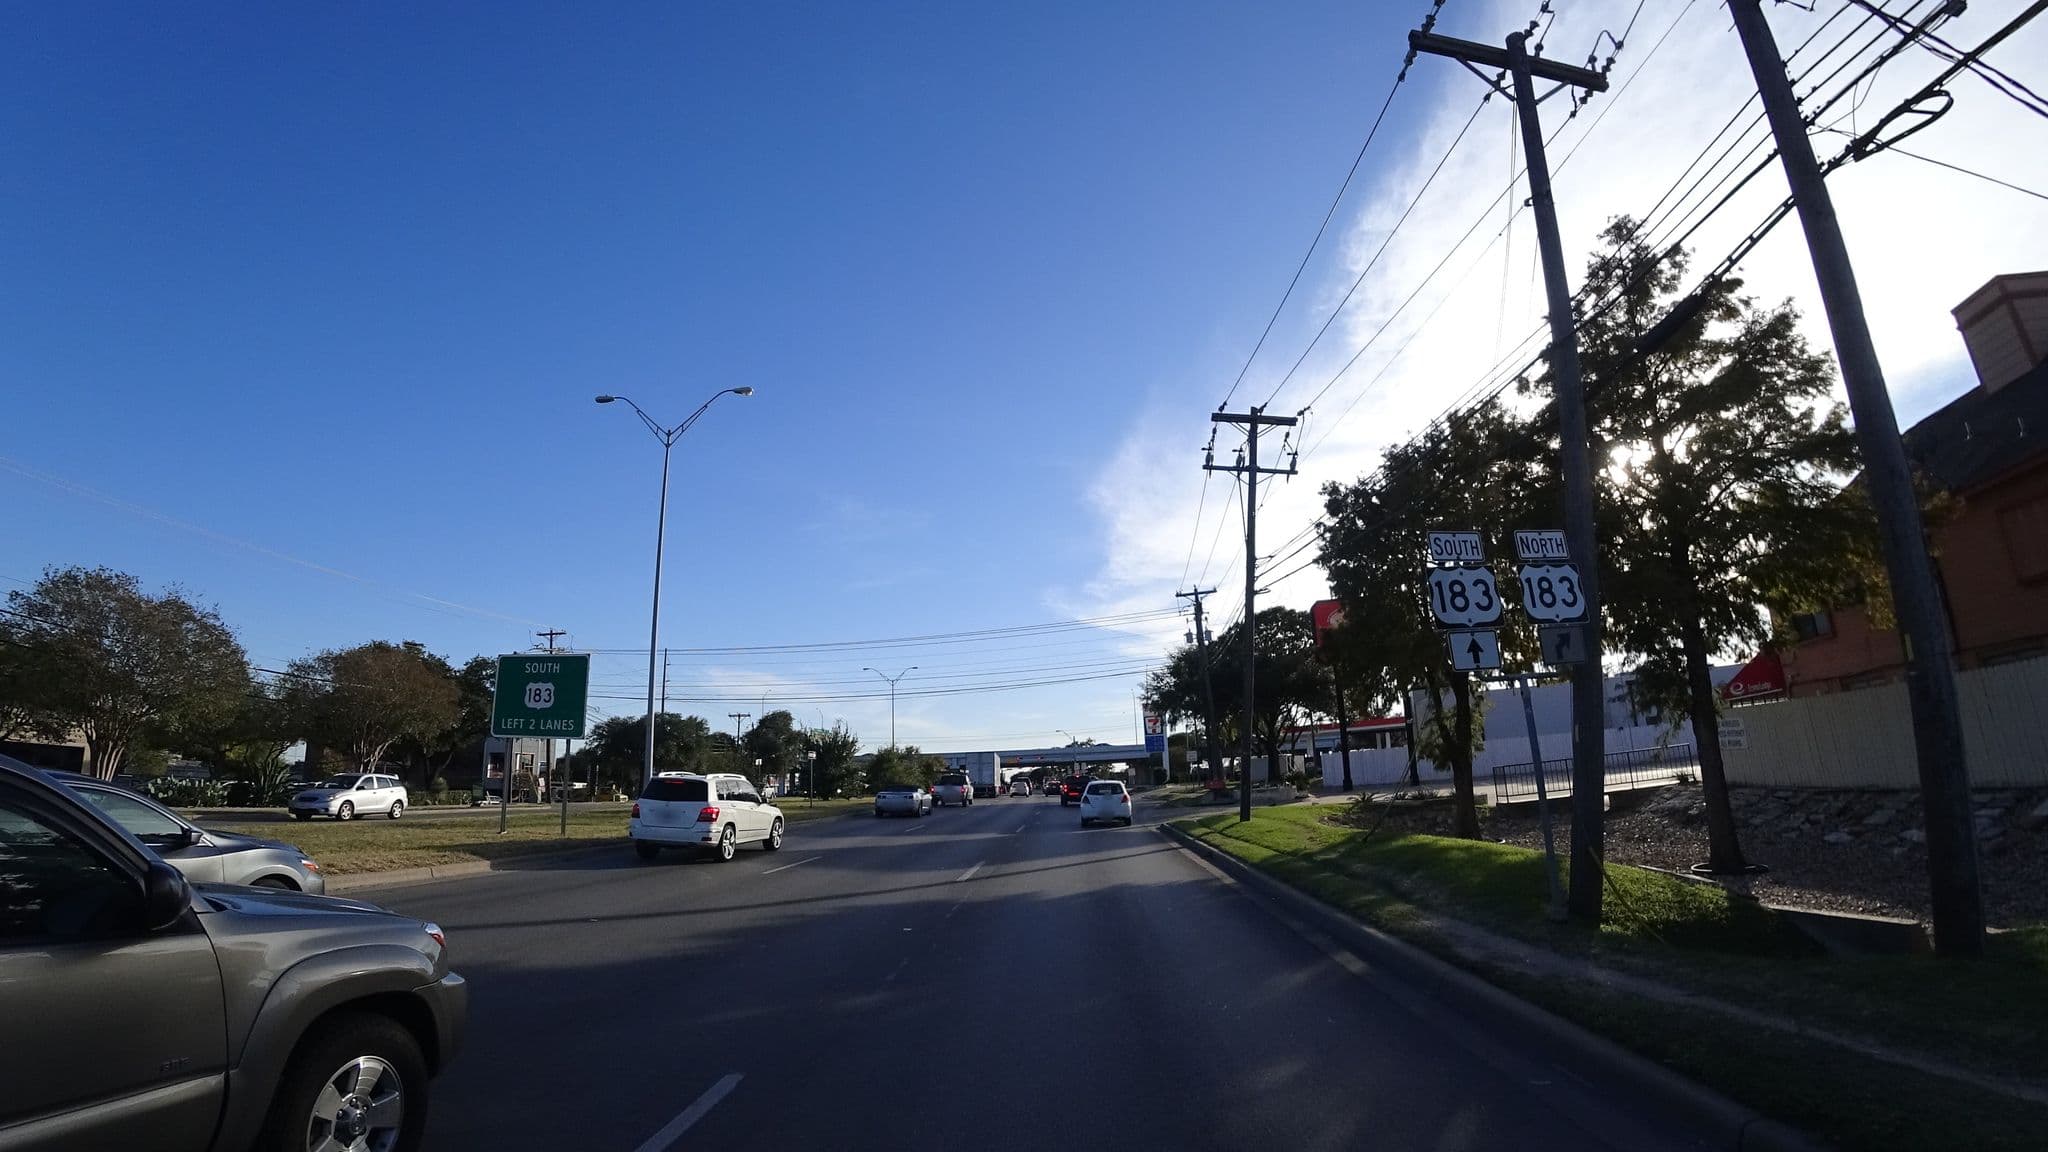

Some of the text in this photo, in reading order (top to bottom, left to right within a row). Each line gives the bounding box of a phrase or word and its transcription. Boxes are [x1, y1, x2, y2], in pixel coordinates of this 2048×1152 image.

[1433, 537, 1480, 556] SOUTH
[1520, 535, 1565, 554] NORTH
[1434, 578, 1494, 613] 183
[1525, 575, 1578, 609] 183
[524, 662, 560, 673] SOUTH
[528, 688, 552, 703] 183
[502, 719, 574, 730] LEFT 2 LANES
